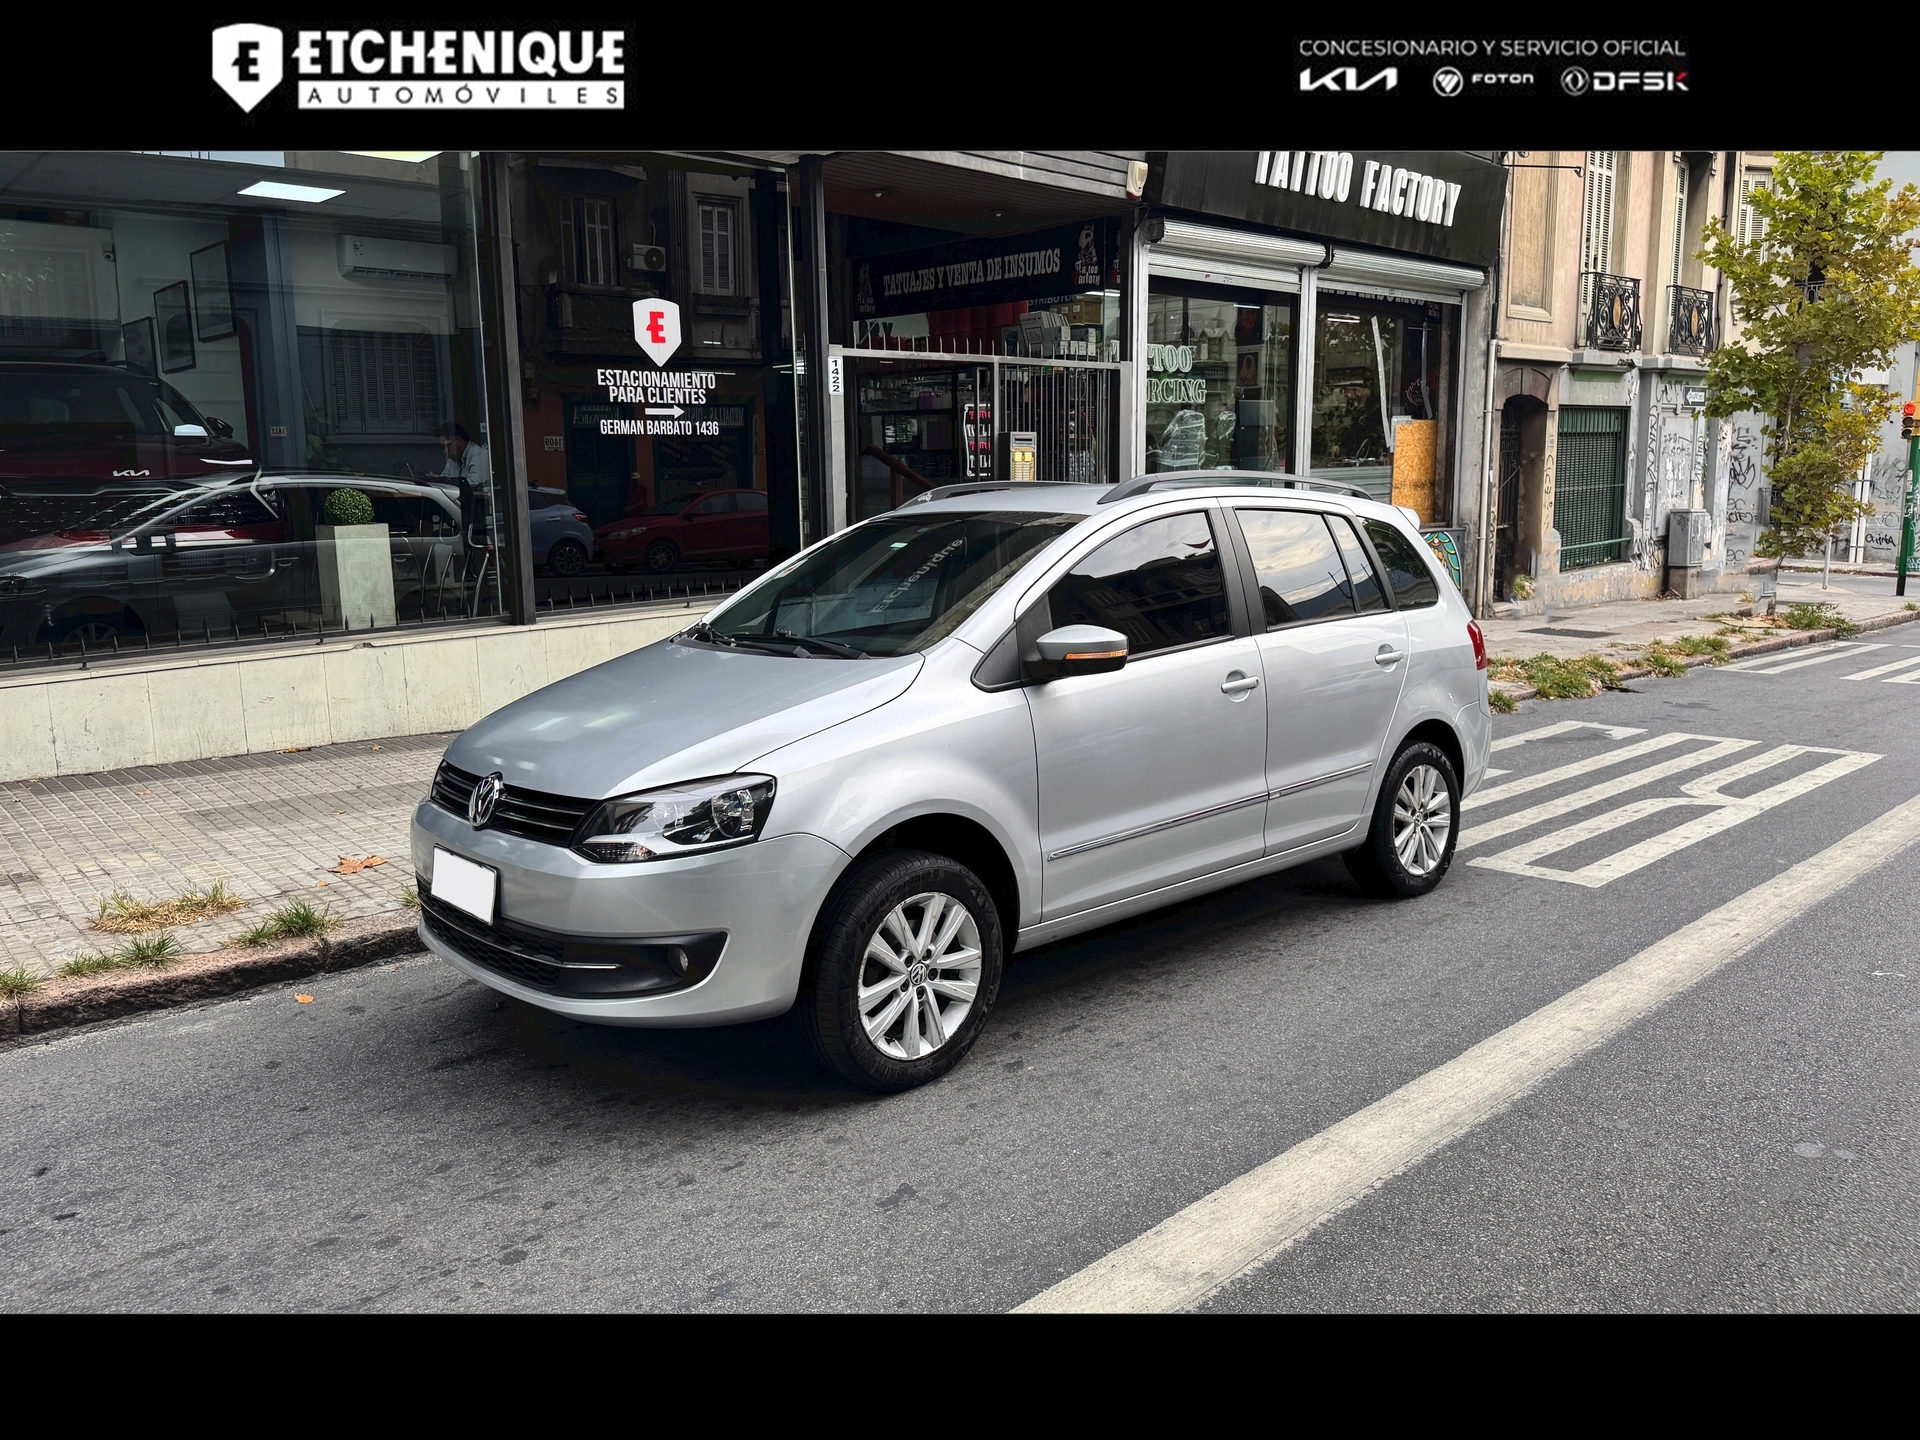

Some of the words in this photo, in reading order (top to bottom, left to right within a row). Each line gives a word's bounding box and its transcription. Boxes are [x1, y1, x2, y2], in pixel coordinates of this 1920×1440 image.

[1254, 151, 1354, 203] TATTOO
[1359, 159, 1462, 227] FACTORY
[883, 267, 936, 297] TATUAJES
[936, 266, 945, 289] Y
[946, 259, 984, 287] VENTA
[985, 256, 1002, 282] DE
[1003, 248, 1061, 279] INSUMOS
[596, 368, 716, 390] ESTACIONAMIENTO
[830, 359, 840, 394] 1422
[609, 386, 645, 403] PARA
[647, 388, 707, 405] CLIENTES
[599, 419, 644, 435] GERMAN
[646, 420, 693, 435] BARBATO
[695, 421, 720, 436] 1436
